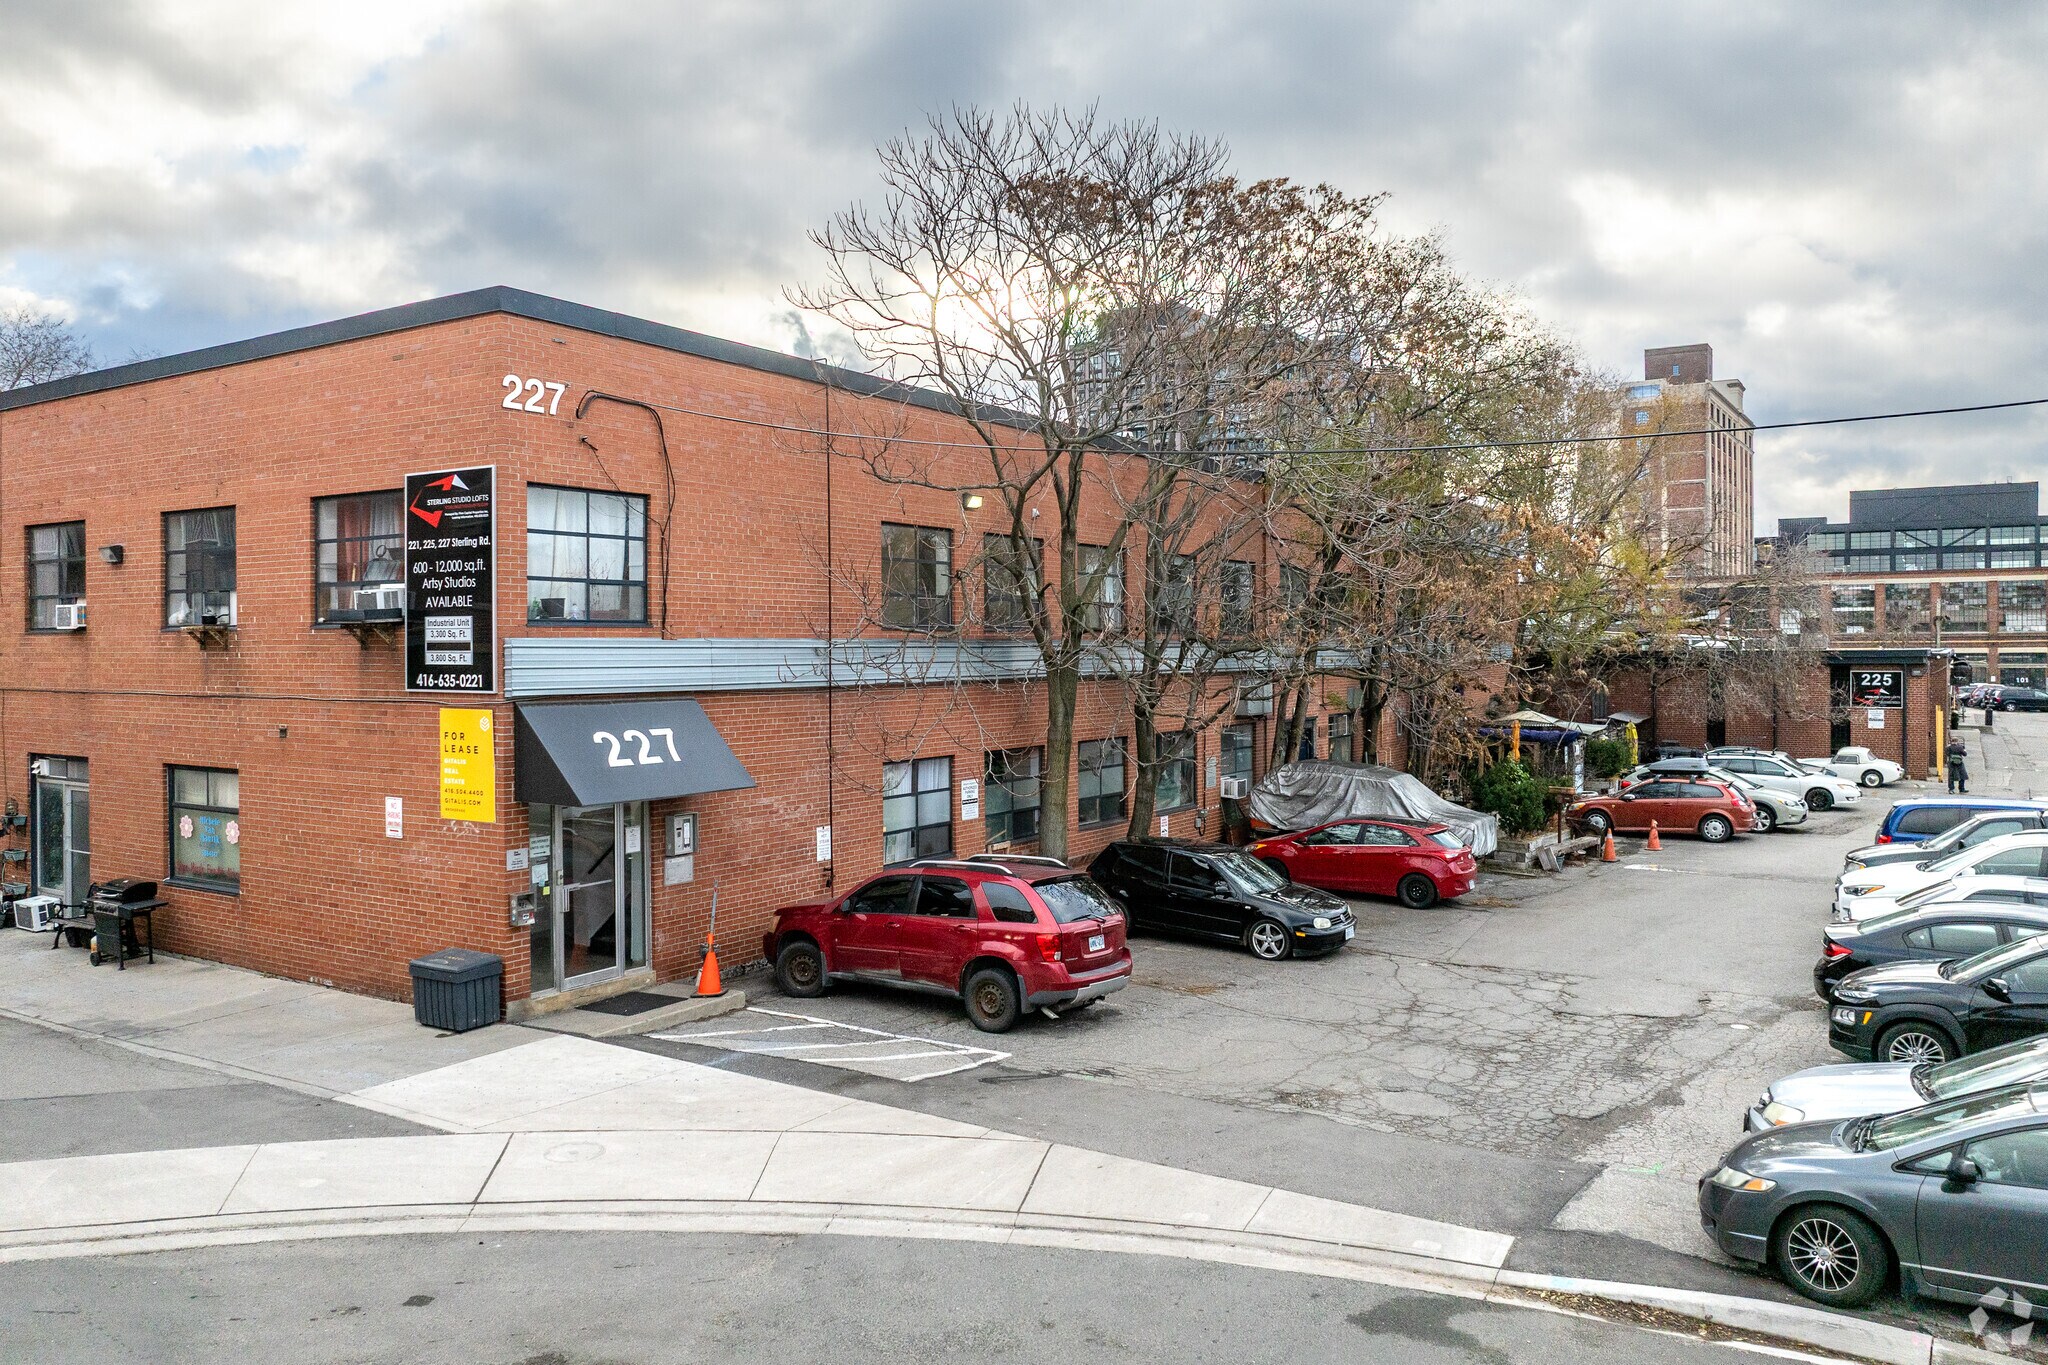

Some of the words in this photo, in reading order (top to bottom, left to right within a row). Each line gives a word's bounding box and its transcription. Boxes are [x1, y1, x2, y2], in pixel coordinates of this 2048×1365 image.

[502, 374, 566, 416] 227
[427, 498, 452, 506] STERLING
[452, 496, 471, 504] STUDIO
[472, 494, 489, 502] LOFTS
[408, 541, 422, 550] 221,
[423, 540, 437, 549] 225,
[438, 538, 450, 548] 227
[451, 537, 477, 548] Sterling
[479, 536, 491, 546] Rd.
[413, 562, 428, 573] 600
[435, 560, 463, 573] 12,000
[464, 559, 486, 573] sq.ft.
[422, 578, 443, 591] Artsy
[444, 576, 476, 589] Studios
[425, 595, 473, 608] AVAILABLE
[427, 619, 455, 627] Industrial
[430, 630, 446, 638] 3,300
[447, 630, 457, 639] Sq.
[459, 630, 467, 638] Ft.
[447, 654, 457, 663] Sq.
[459, 654, 467, 662] Ft.
[416, 673, 483, 688] 416-635-0221
[1861, 673, 1892, 686] 225
[444, 731, 465, 741] FOR
[444, 744, 479, 754] LEASE
[593, 727, 682, 768] 227
[444, 798, 481, 806] GITALIS.COM
